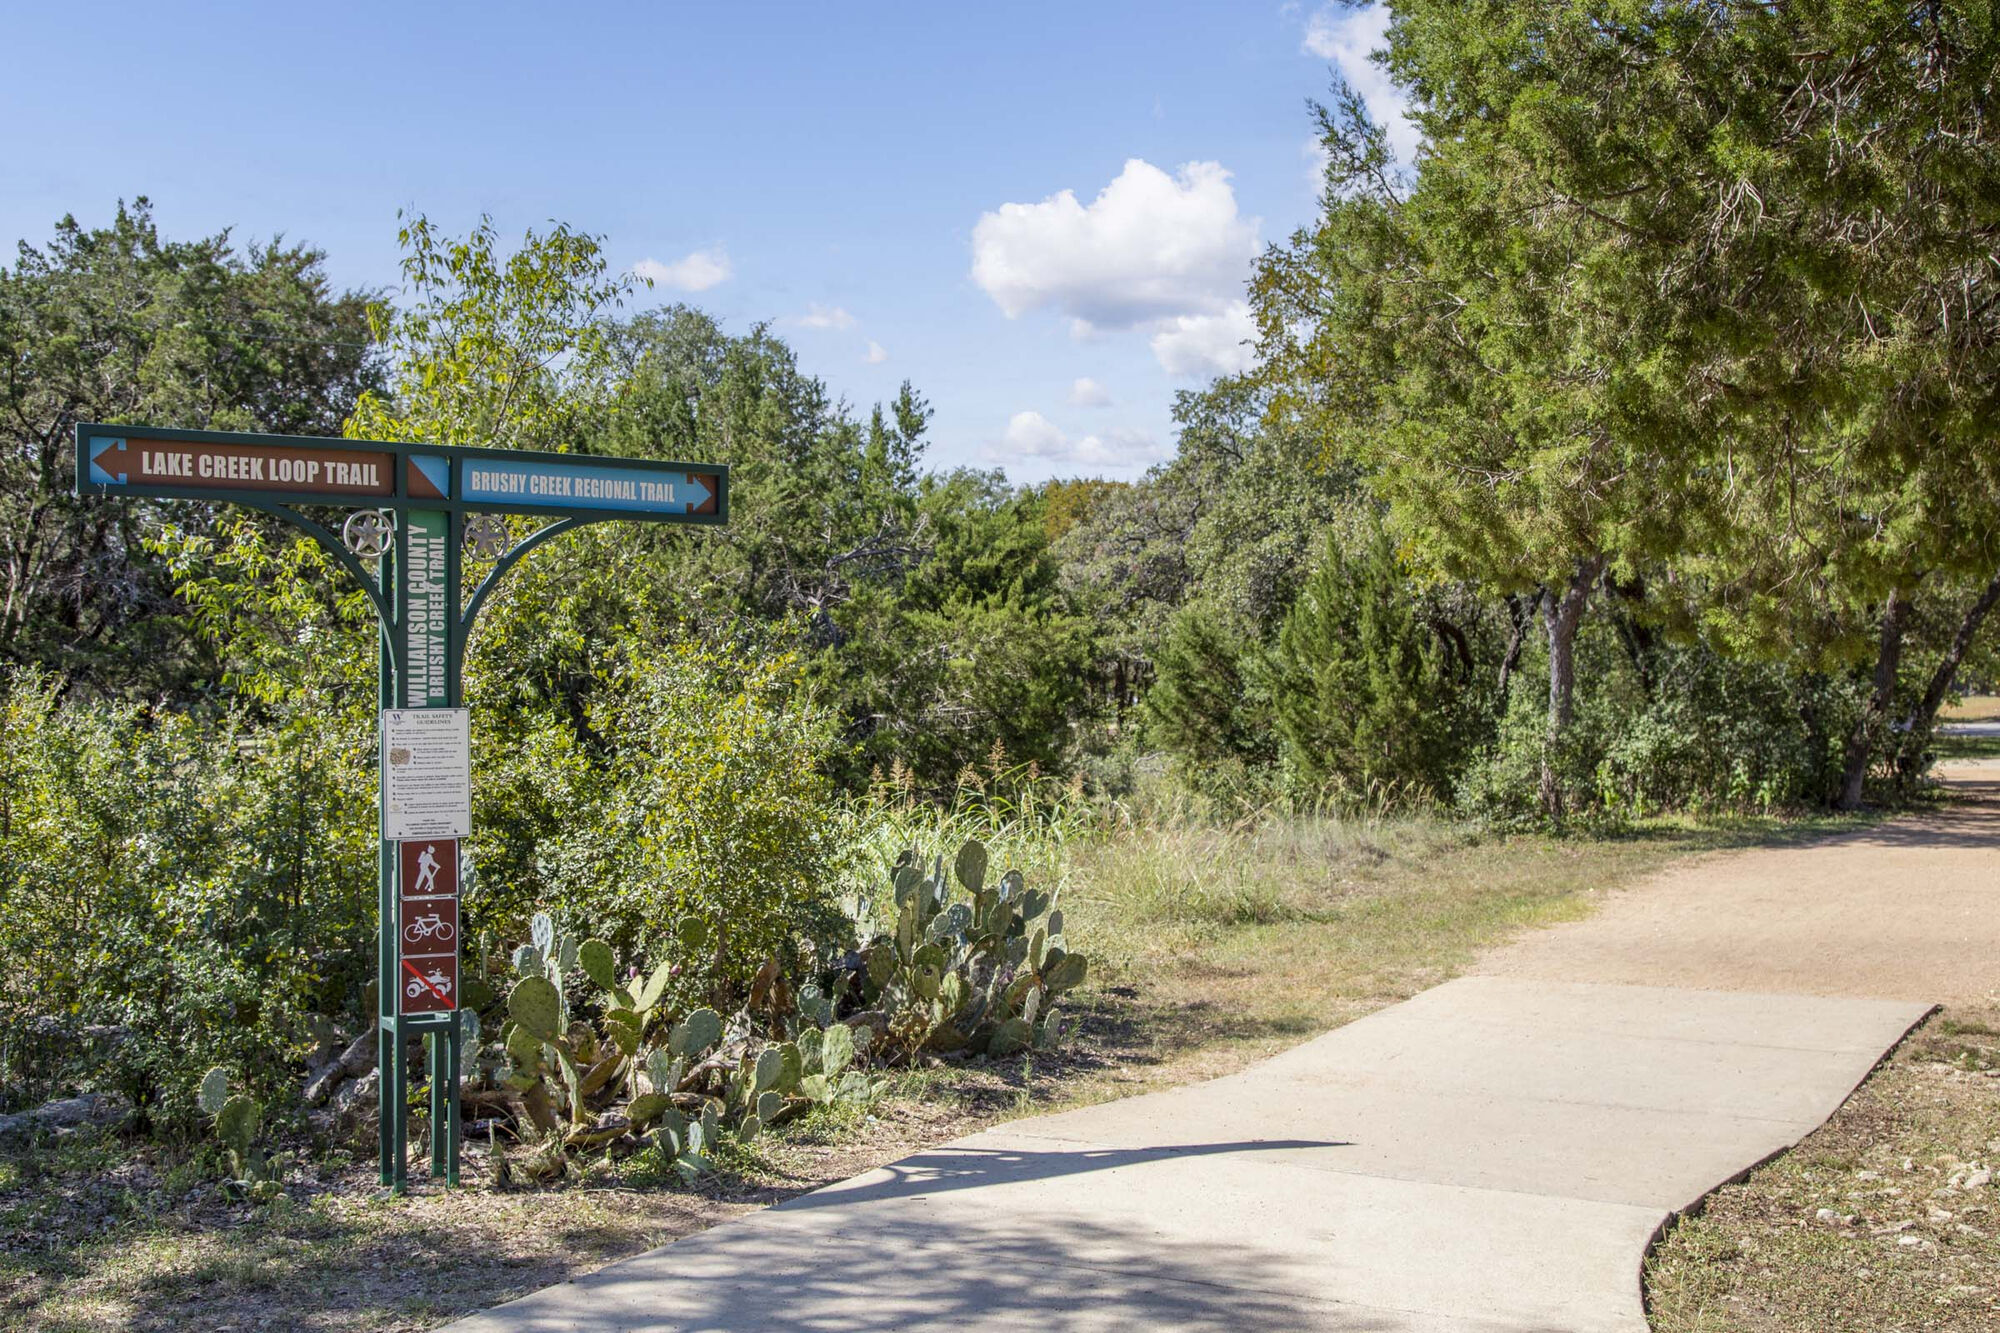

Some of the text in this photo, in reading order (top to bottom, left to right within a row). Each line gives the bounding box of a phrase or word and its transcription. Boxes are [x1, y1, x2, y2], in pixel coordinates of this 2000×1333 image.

[142, 451, 380, 486] LAKE CREEK LOOP TRAIL
[471, 471, 675, 503] BRUSHY CREEK REGIONAL TRAIL
[407, 524, 428, 708] WILLIAMSON COUNTY
[429, 536, 445, 697] BRUSHY CREEK TRAIL
